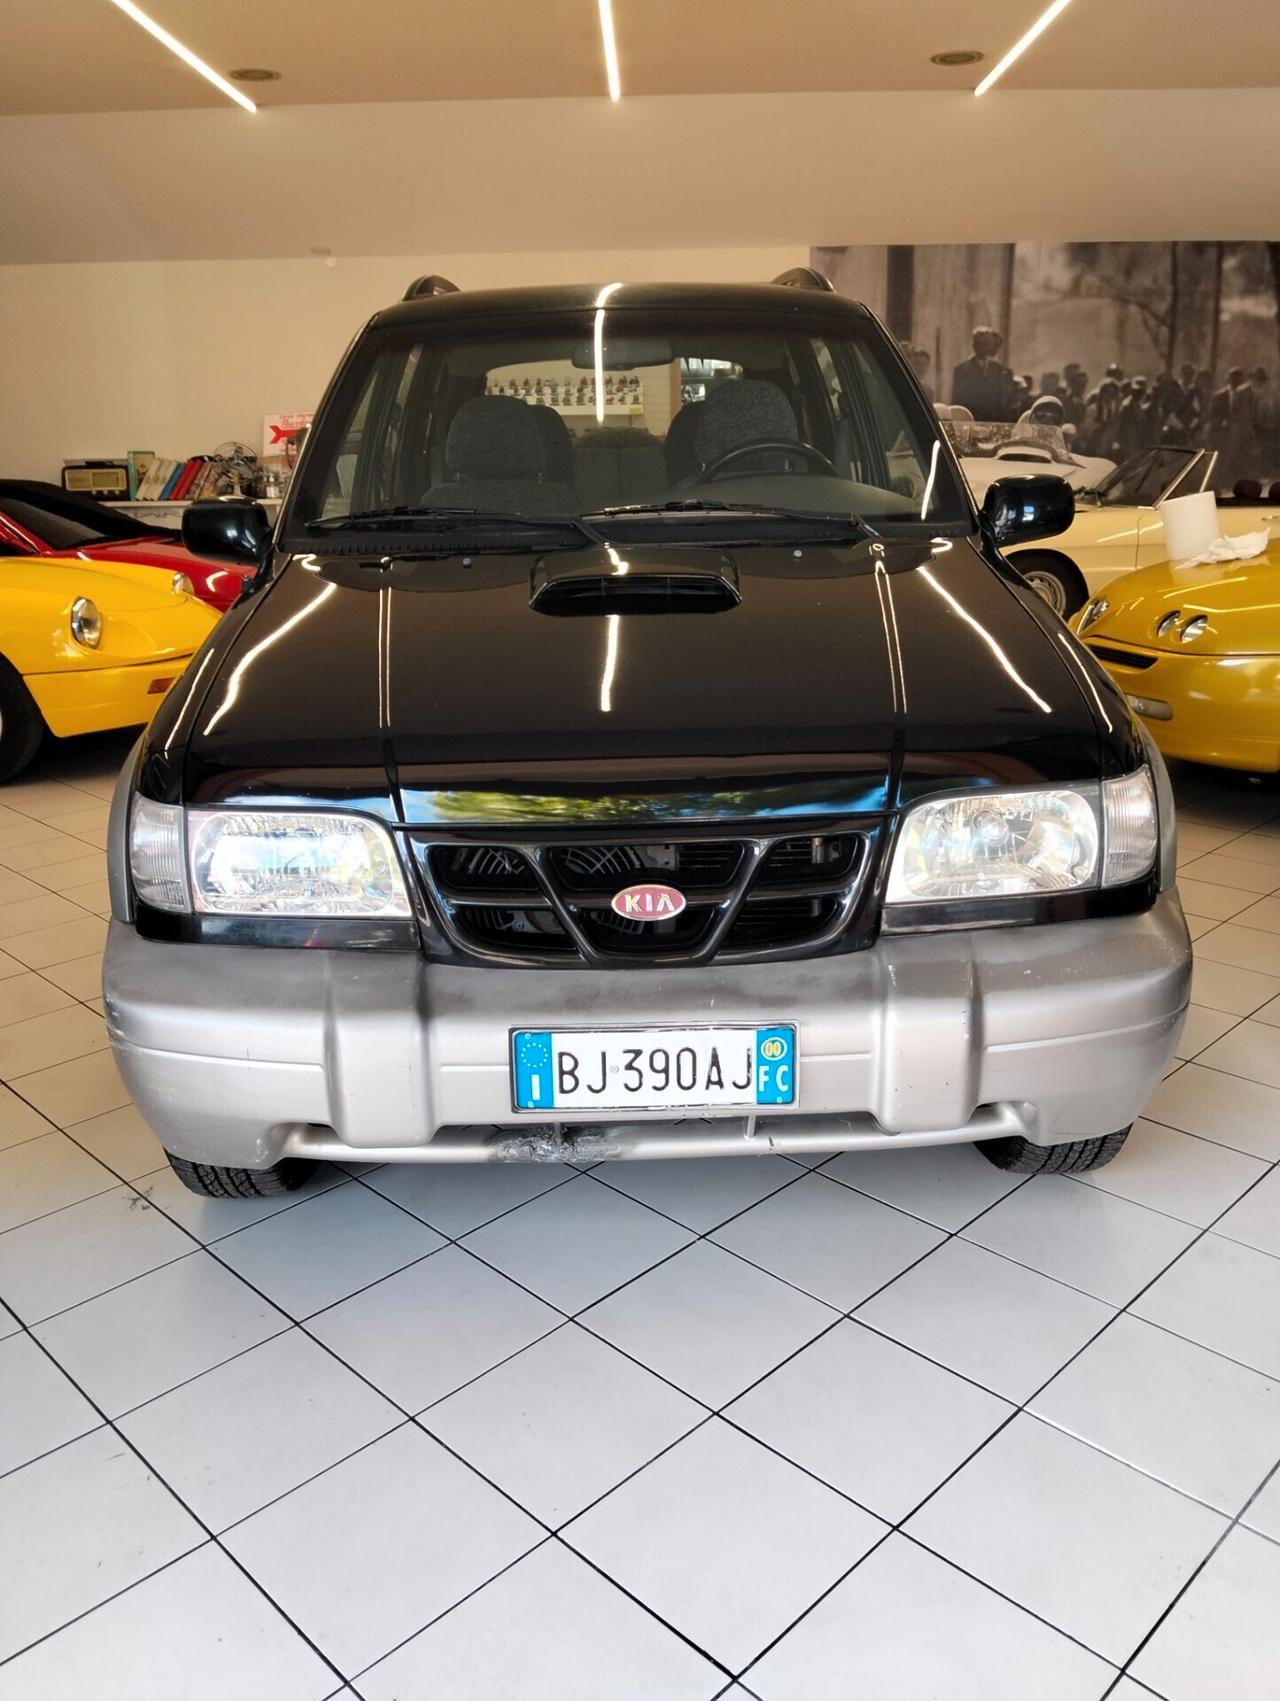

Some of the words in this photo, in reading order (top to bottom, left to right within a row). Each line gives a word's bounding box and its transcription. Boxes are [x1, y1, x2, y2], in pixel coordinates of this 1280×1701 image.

[624, 893, 675, 913] KIA
[531, 1074, 541, 1101] I
[758, 1064, 789, 1093] FC
